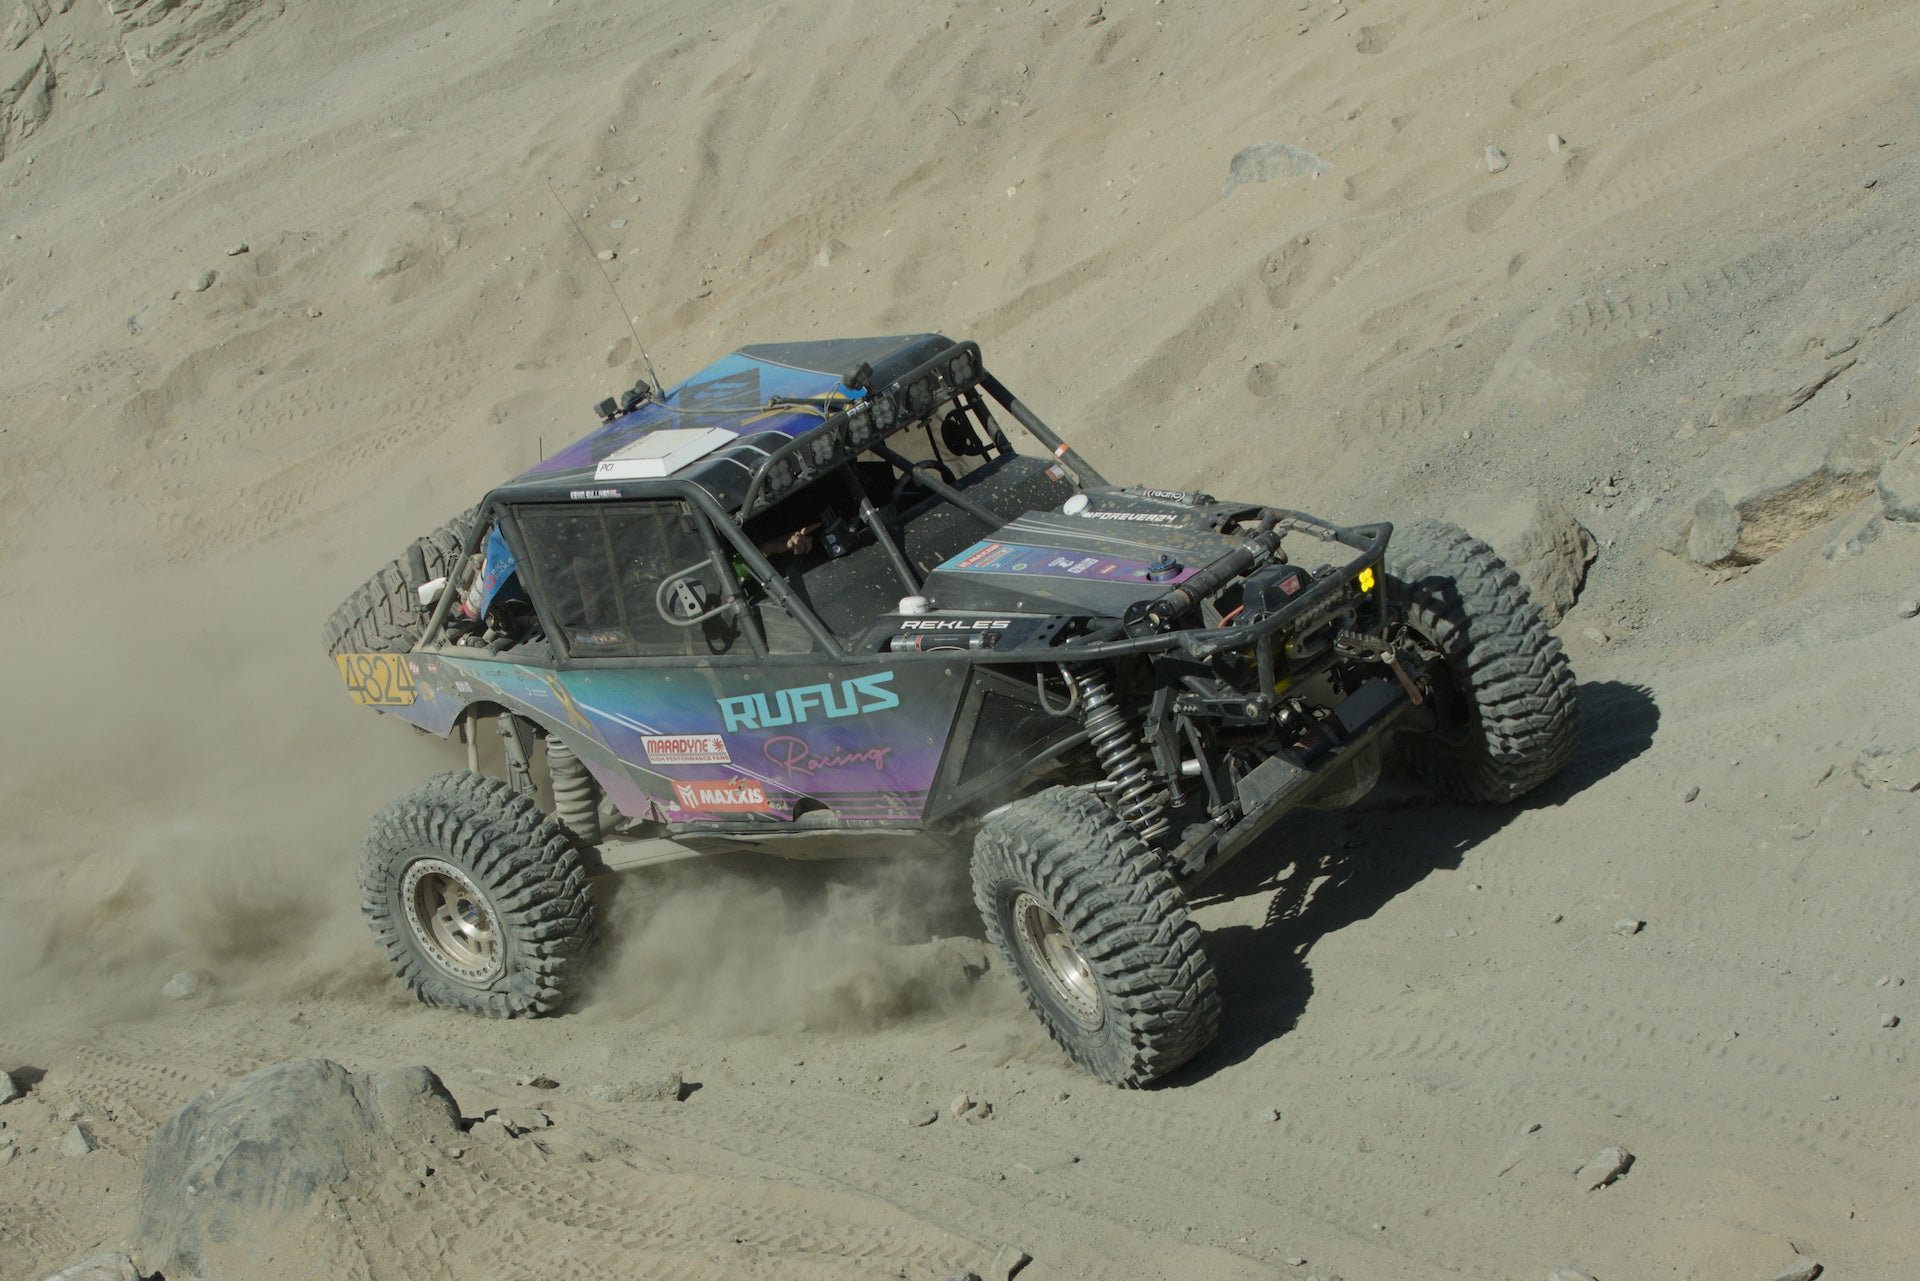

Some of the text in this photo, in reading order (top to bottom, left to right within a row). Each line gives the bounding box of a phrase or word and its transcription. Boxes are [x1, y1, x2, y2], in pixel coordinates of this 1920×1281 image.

[600, 463, 615, 471] PCI
[900, 620, 1011, 629] REKLES
[347, 655, 417, 703] 4824
[716, 670, 900, 733] RUFUS
[647, 738, 708, 754] MARADYNE
[763, 735, 892, 779] Racing
[700, 787, 764, 805] MAXXIS
